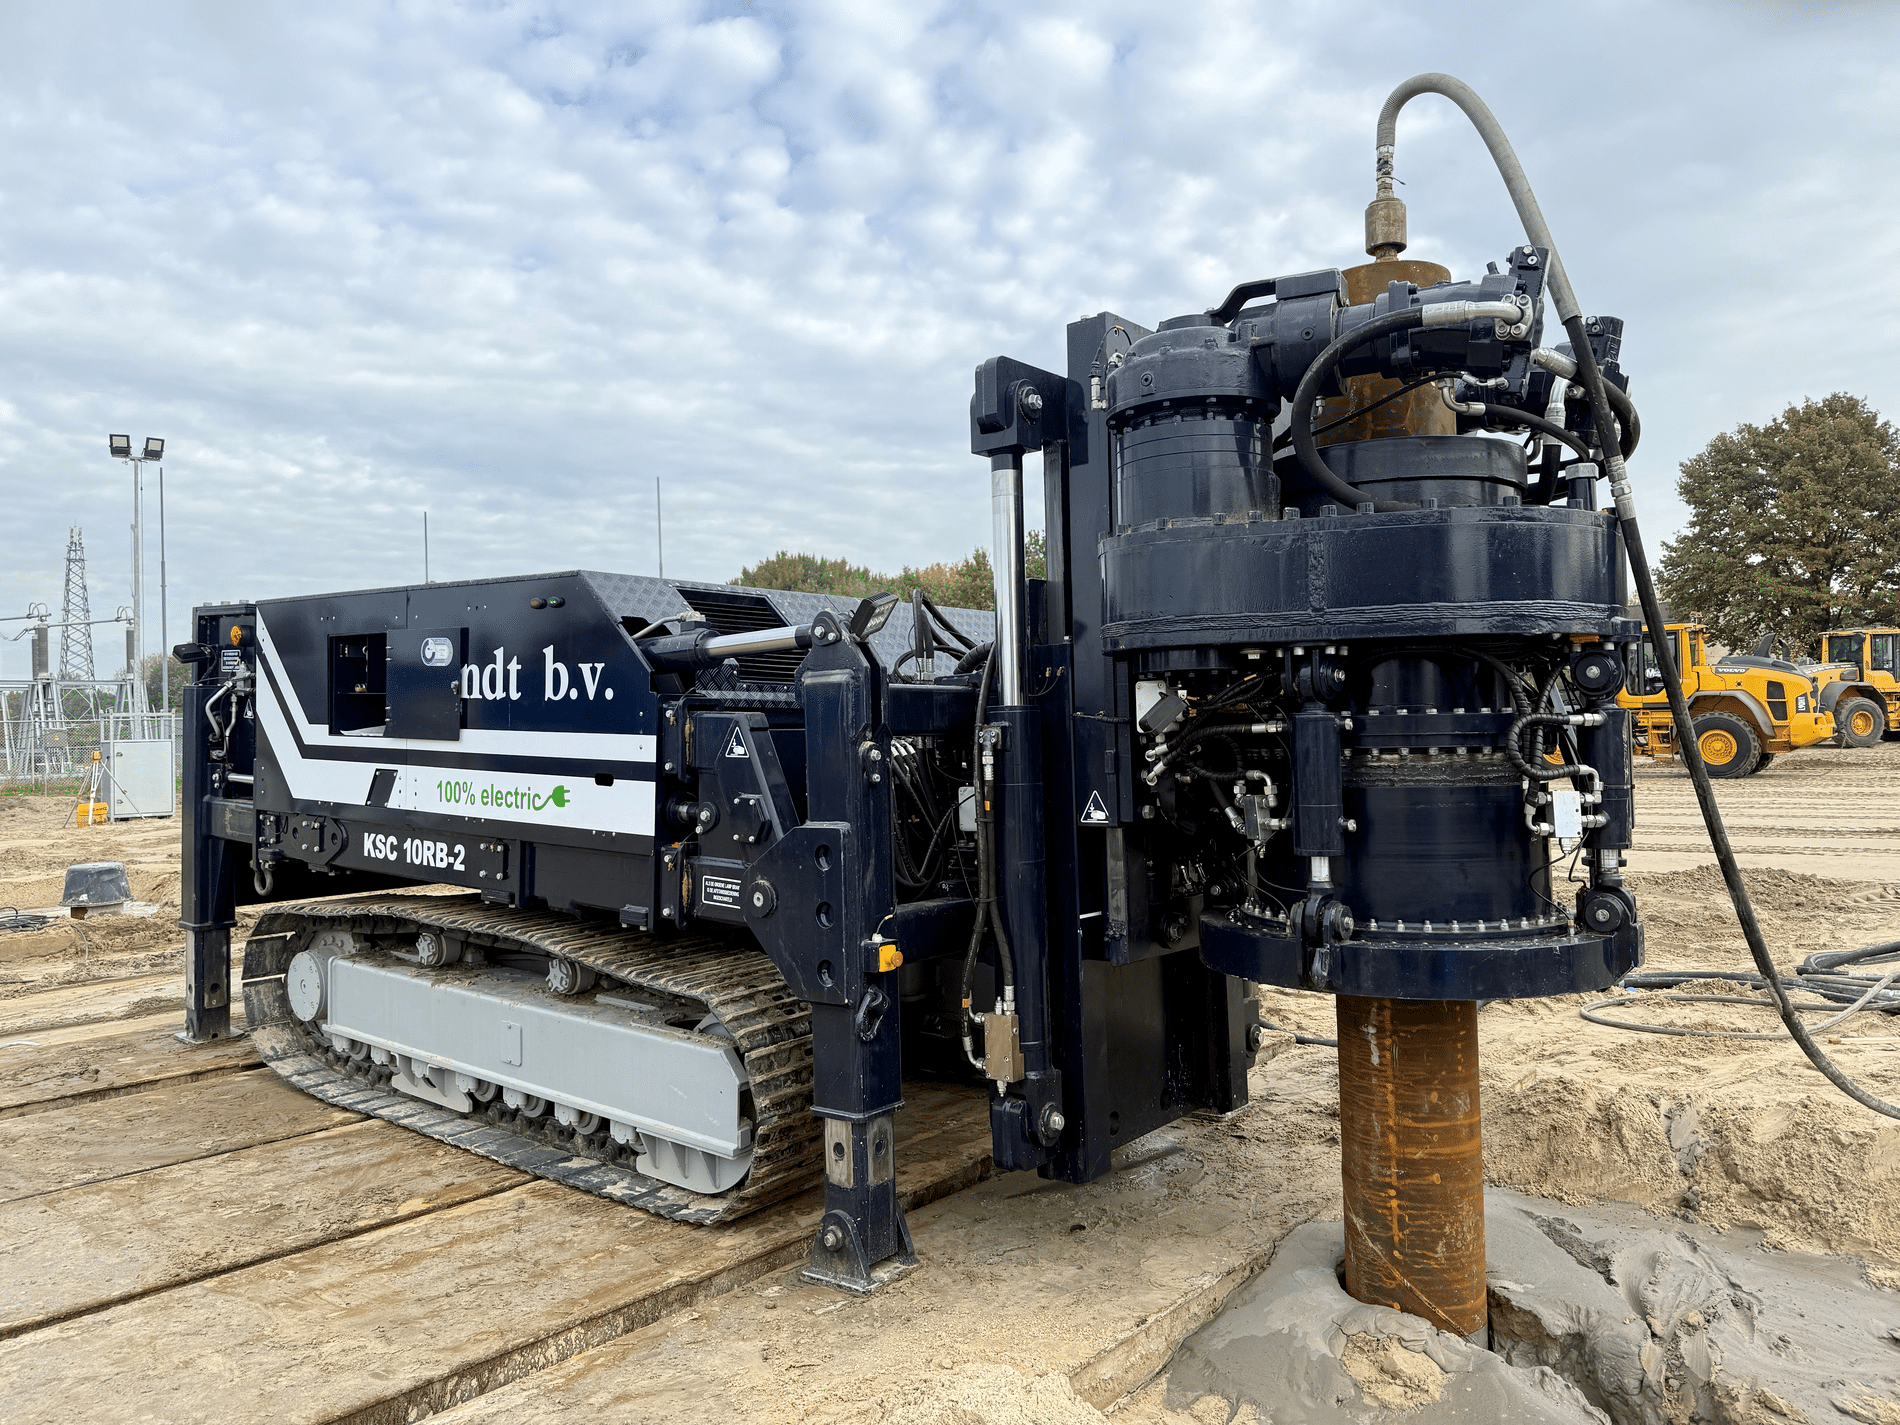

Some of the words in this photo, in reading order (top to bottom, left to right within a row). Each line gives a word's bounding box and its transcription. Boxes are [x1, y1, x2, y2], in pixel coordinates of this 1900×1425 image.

[460, 646, 522, 701] ndt
[542, 644, 614, 701] b.v.
[436, 780, 476, 806] 100%
[480, 783, 544, 811] electric
[363, 832, 398, 861] KSC
[403, 837, 466, 872] 10RB-2
